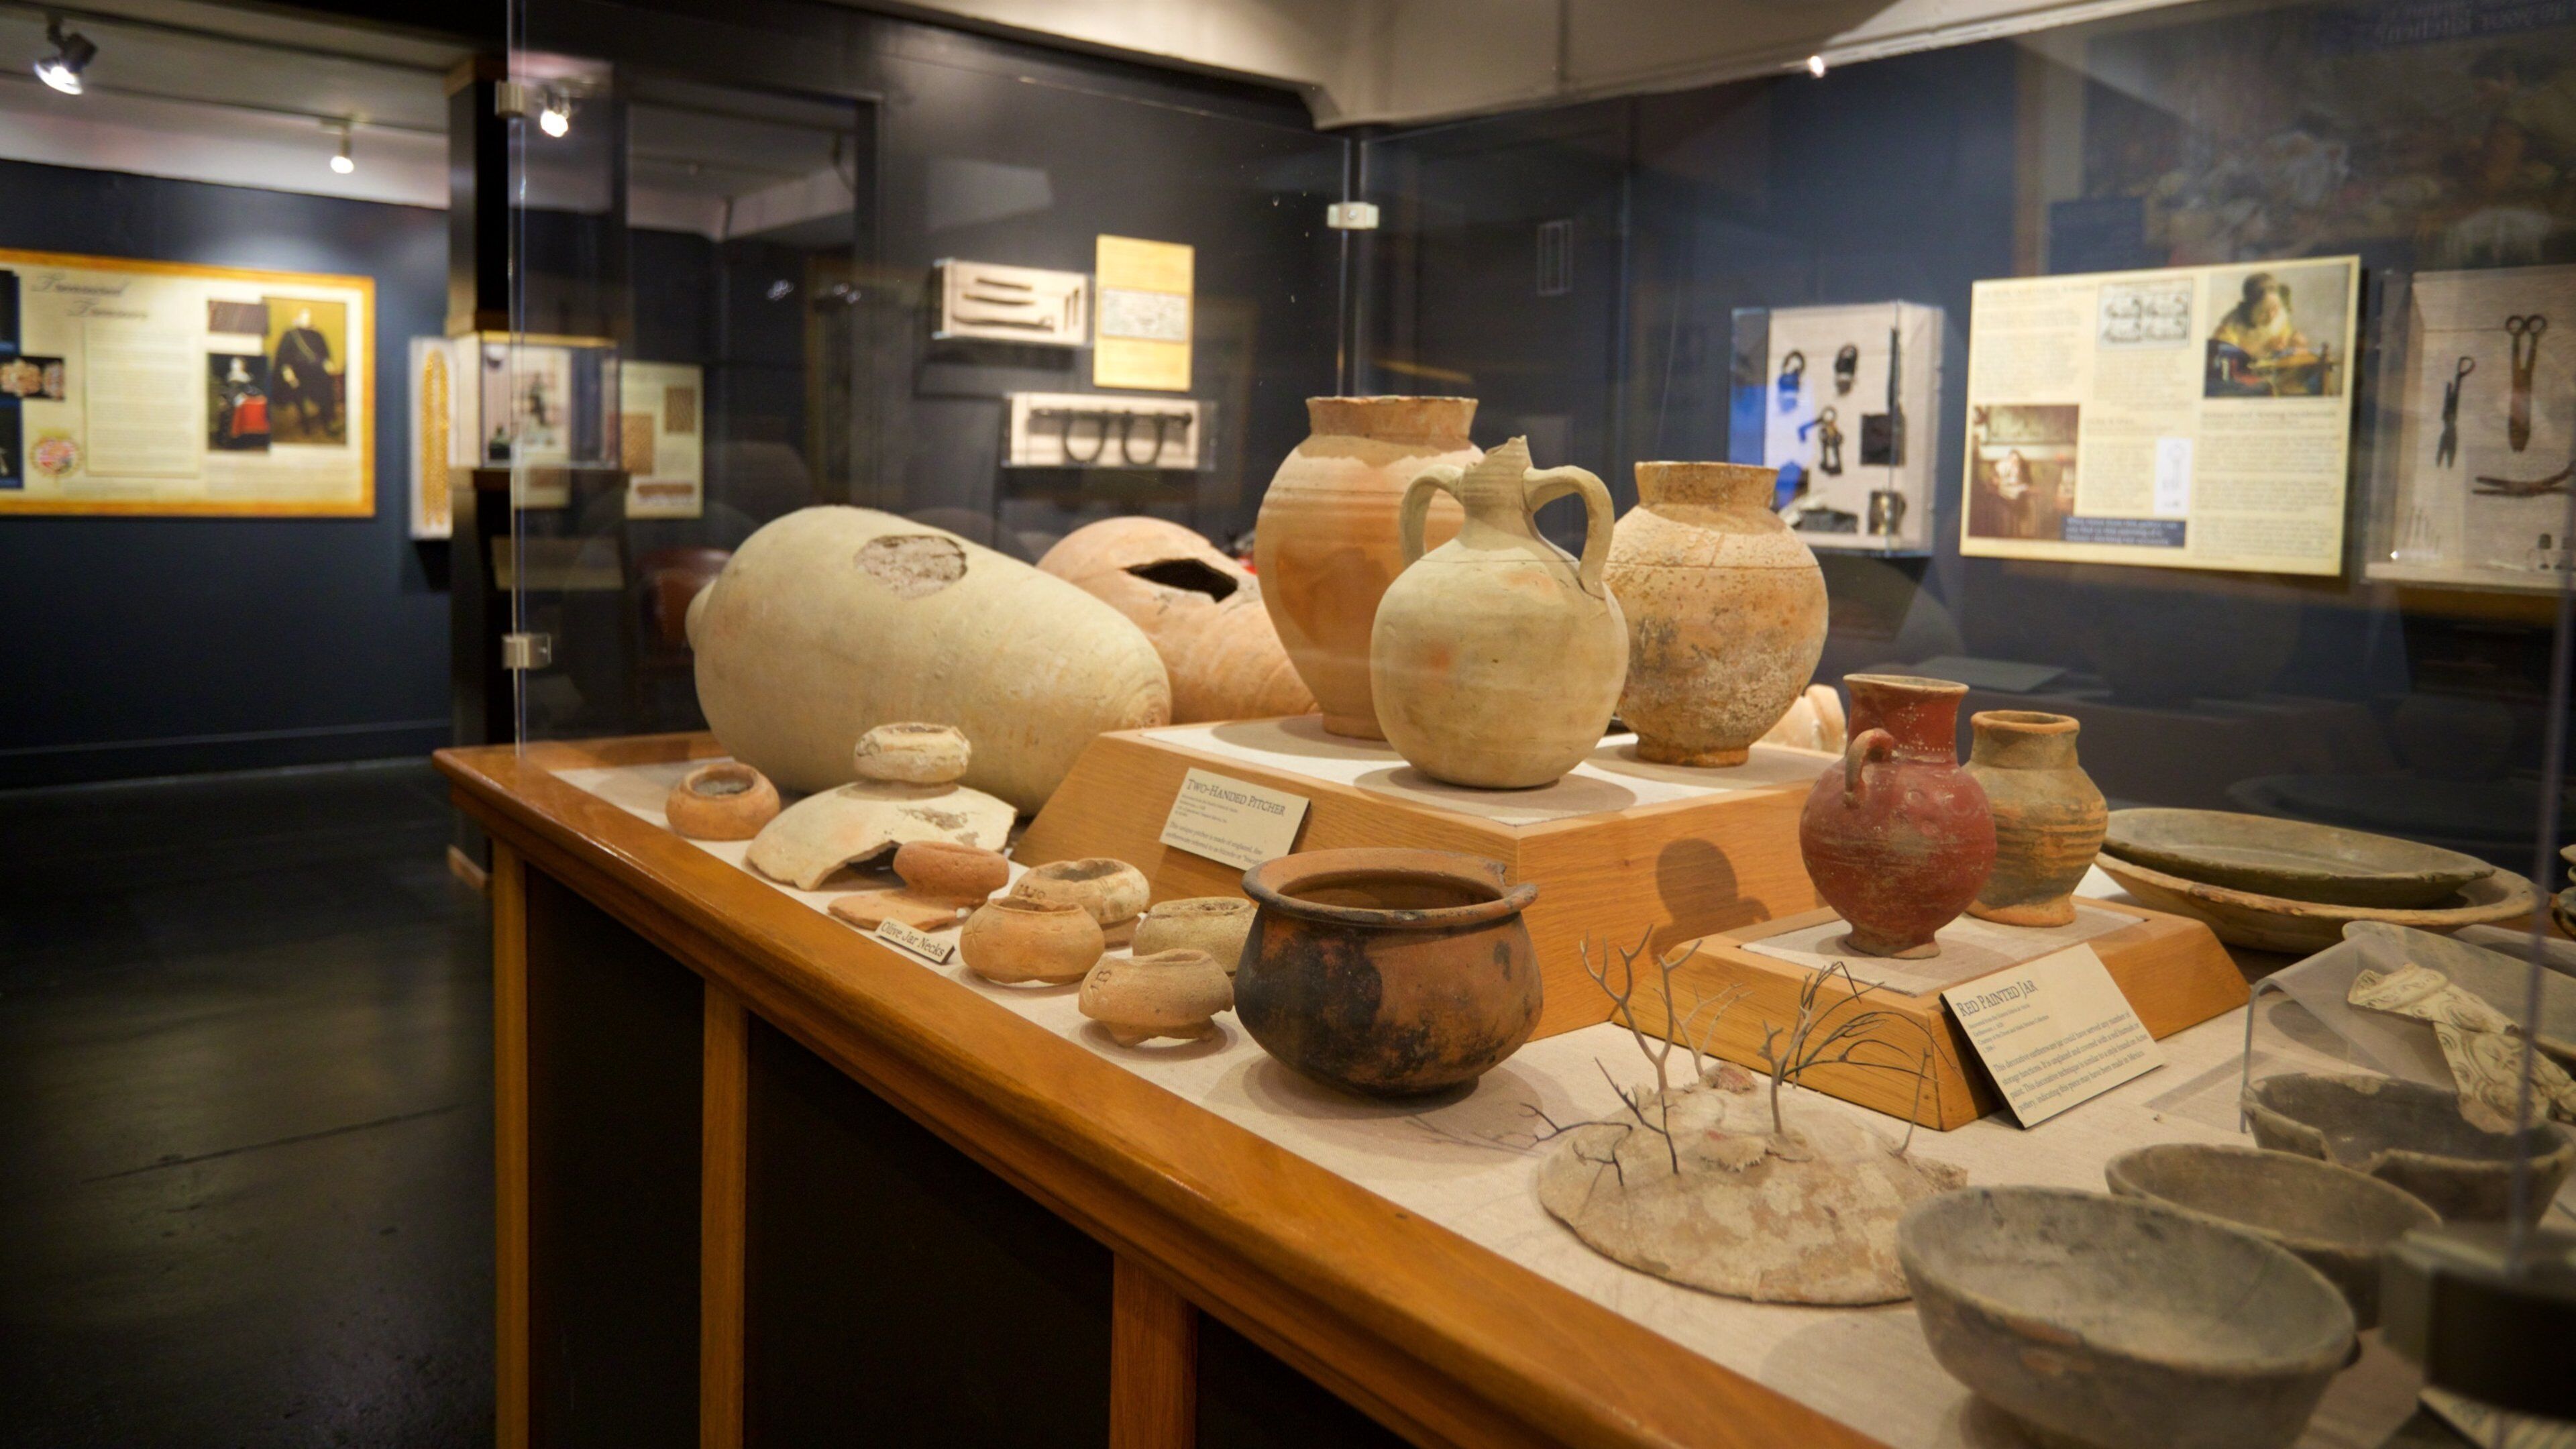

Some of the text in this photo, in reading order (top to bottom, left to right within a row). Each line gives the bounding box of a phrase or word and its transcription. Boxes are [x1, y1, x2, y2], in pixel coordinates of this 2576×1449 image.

[1186, 779, 1248, 805] TWO-HANDED
[1249, 796, 1285, 816] PITCHER
[881, 921, 945, 957] Olive Jar Necks
[1955, 1000, 1980, 1017] RED
[1976, 986, 2021, 1009] PAINTED
[2017, 980, 2039, 1000] JAR
